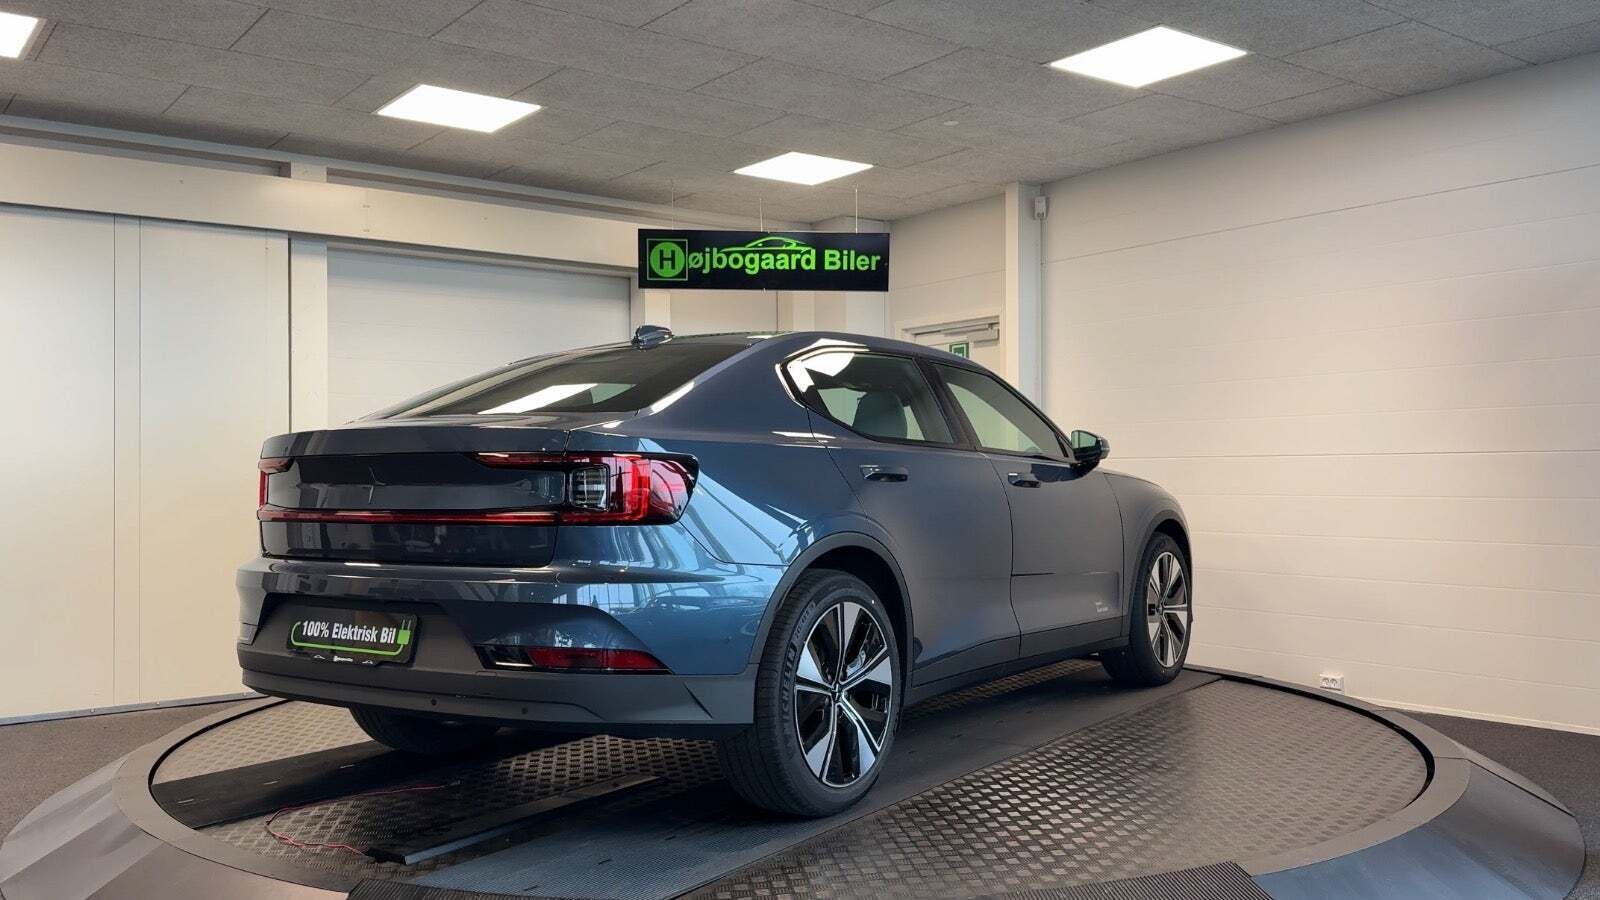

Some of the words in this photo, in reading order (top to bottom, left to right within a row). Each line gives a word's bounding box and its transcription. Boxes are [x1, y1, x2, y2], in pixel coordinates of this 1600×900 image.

[657, 248, 816, 275] Højbogaard
[824, 249, 881, 271] Biler
[302, 620, 329, 638] 100%
[332, 623, 378, 643] Elektrisk
[380, 627, 397, 644] Bil
